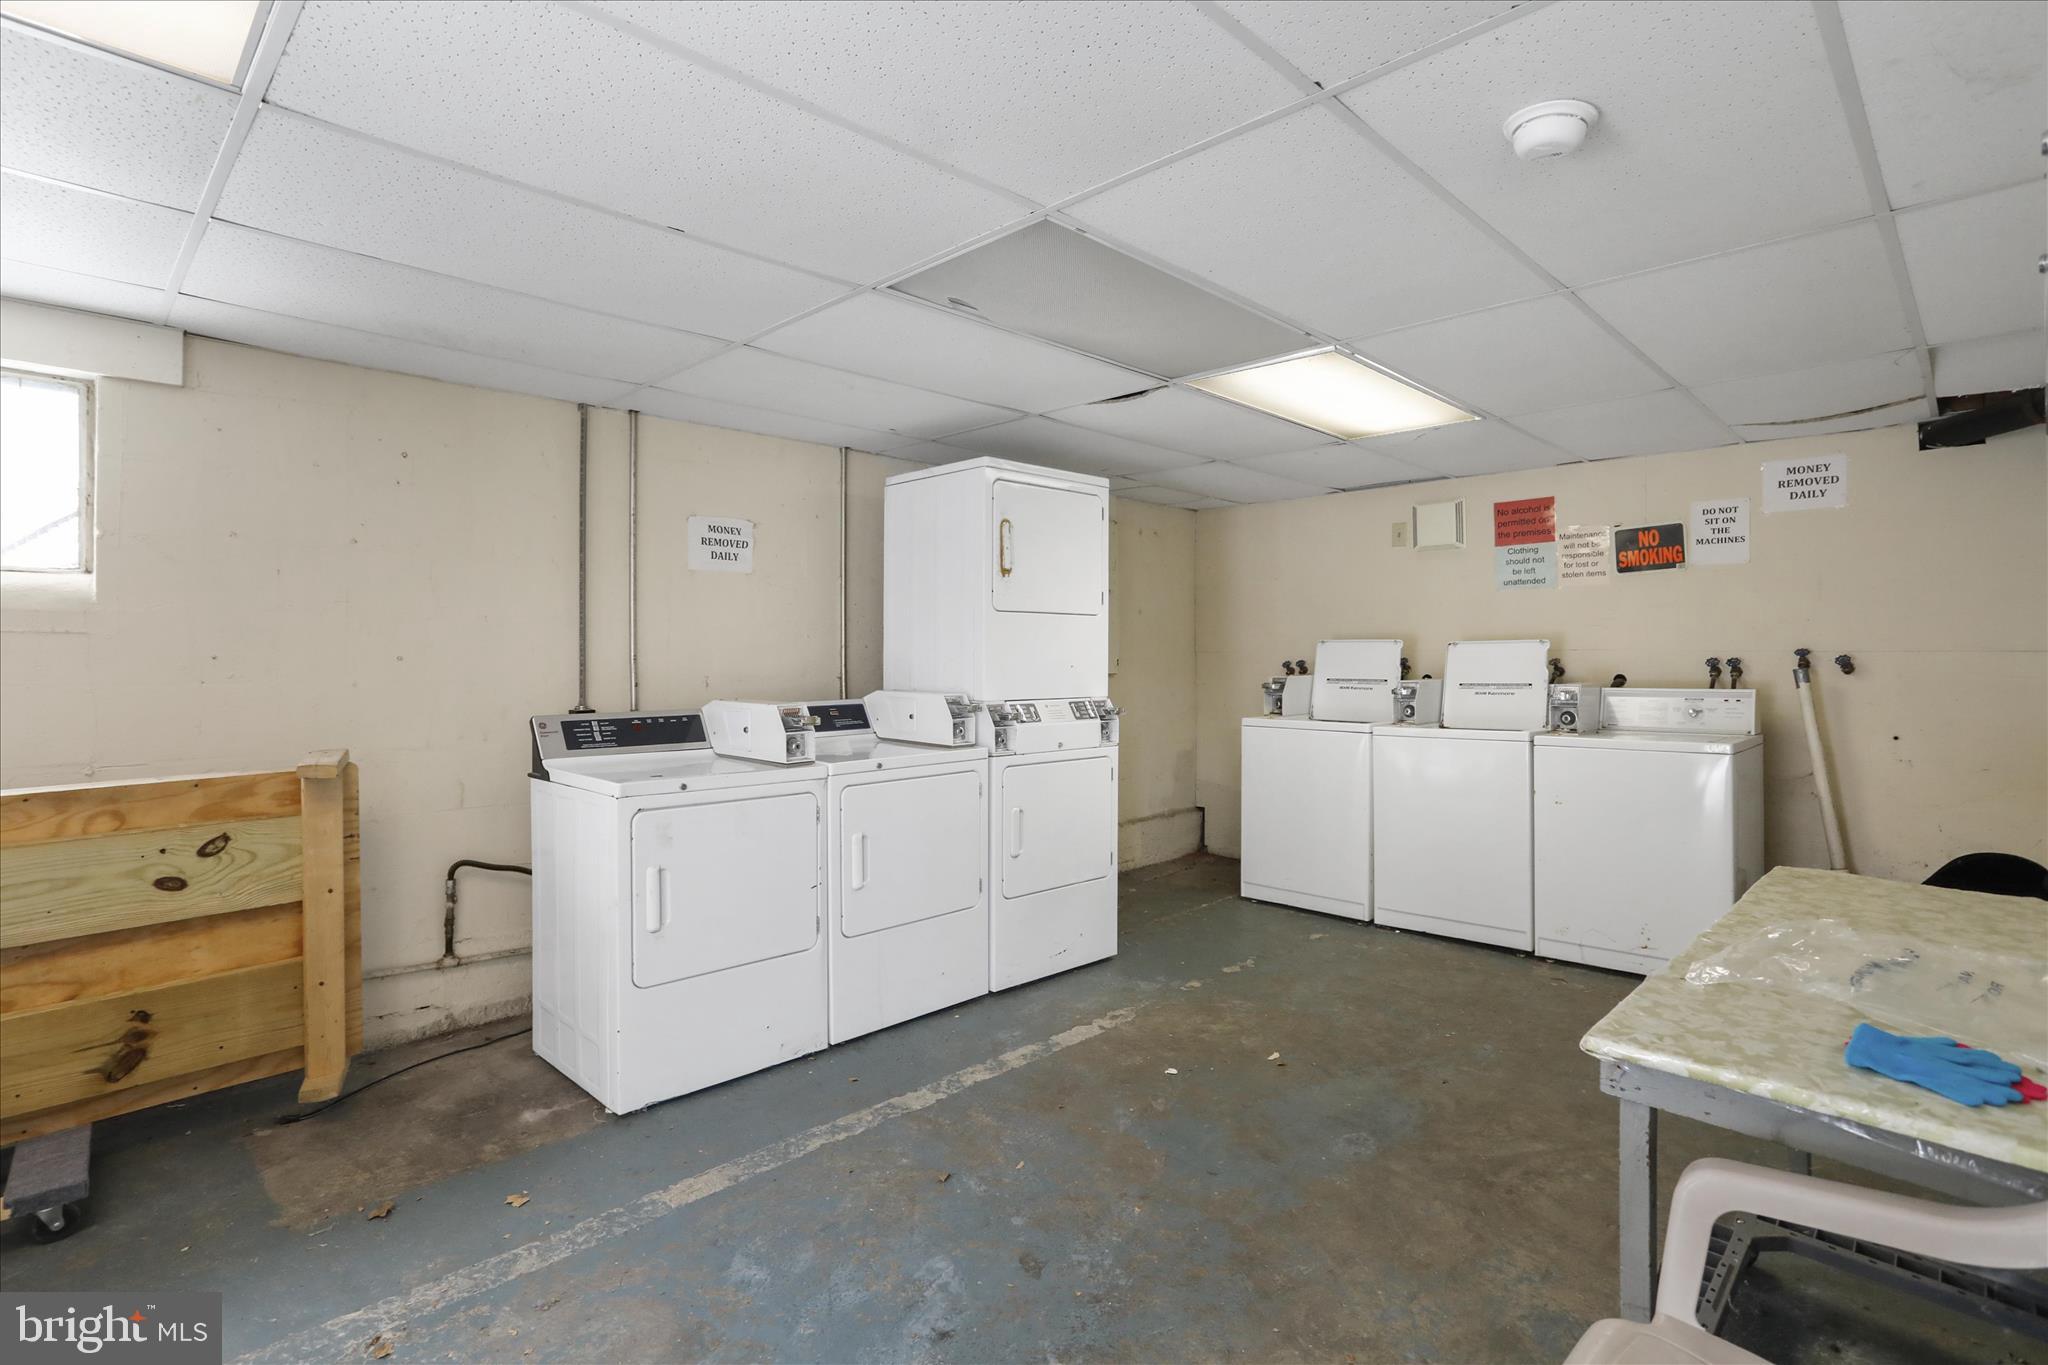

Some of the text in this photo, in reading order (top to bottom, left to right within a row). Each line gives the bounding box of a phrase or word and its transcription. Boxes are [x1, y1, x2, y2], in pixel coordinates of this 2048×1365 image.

[1786, 463, 1831, 475] MONEY
[1778, 475, 1840, 489] REMOVED
[1789, 489, 1828, 500] DAILY
[1511, 505, 1542, 515] alcohol
[1702, 506, 1739, 516] DO NOT
[1497, 518, 1536, 528] permitted
[1722, 516, 1736, 524] ON
[707, 524, 742, 536] MONEY
[1497, 528, 1552, 539] the premises
[1711, 526, 1731, 534] THE
[701, 537, 749, 549] REMOVED
[1638, 529, 1660, 547] NO
[1695, 535, 1746, 546] MACHINES
[710, 550, 739, 561] DAILY
[1507, 547, 1539, 555] Clothing
[1561, 551, 1604, 559] responsible
[1618, 545, 1683, 568] SMOKING
[1505, 557, 1530, 565] should
[1503, 577, 1546, 586] unattended
